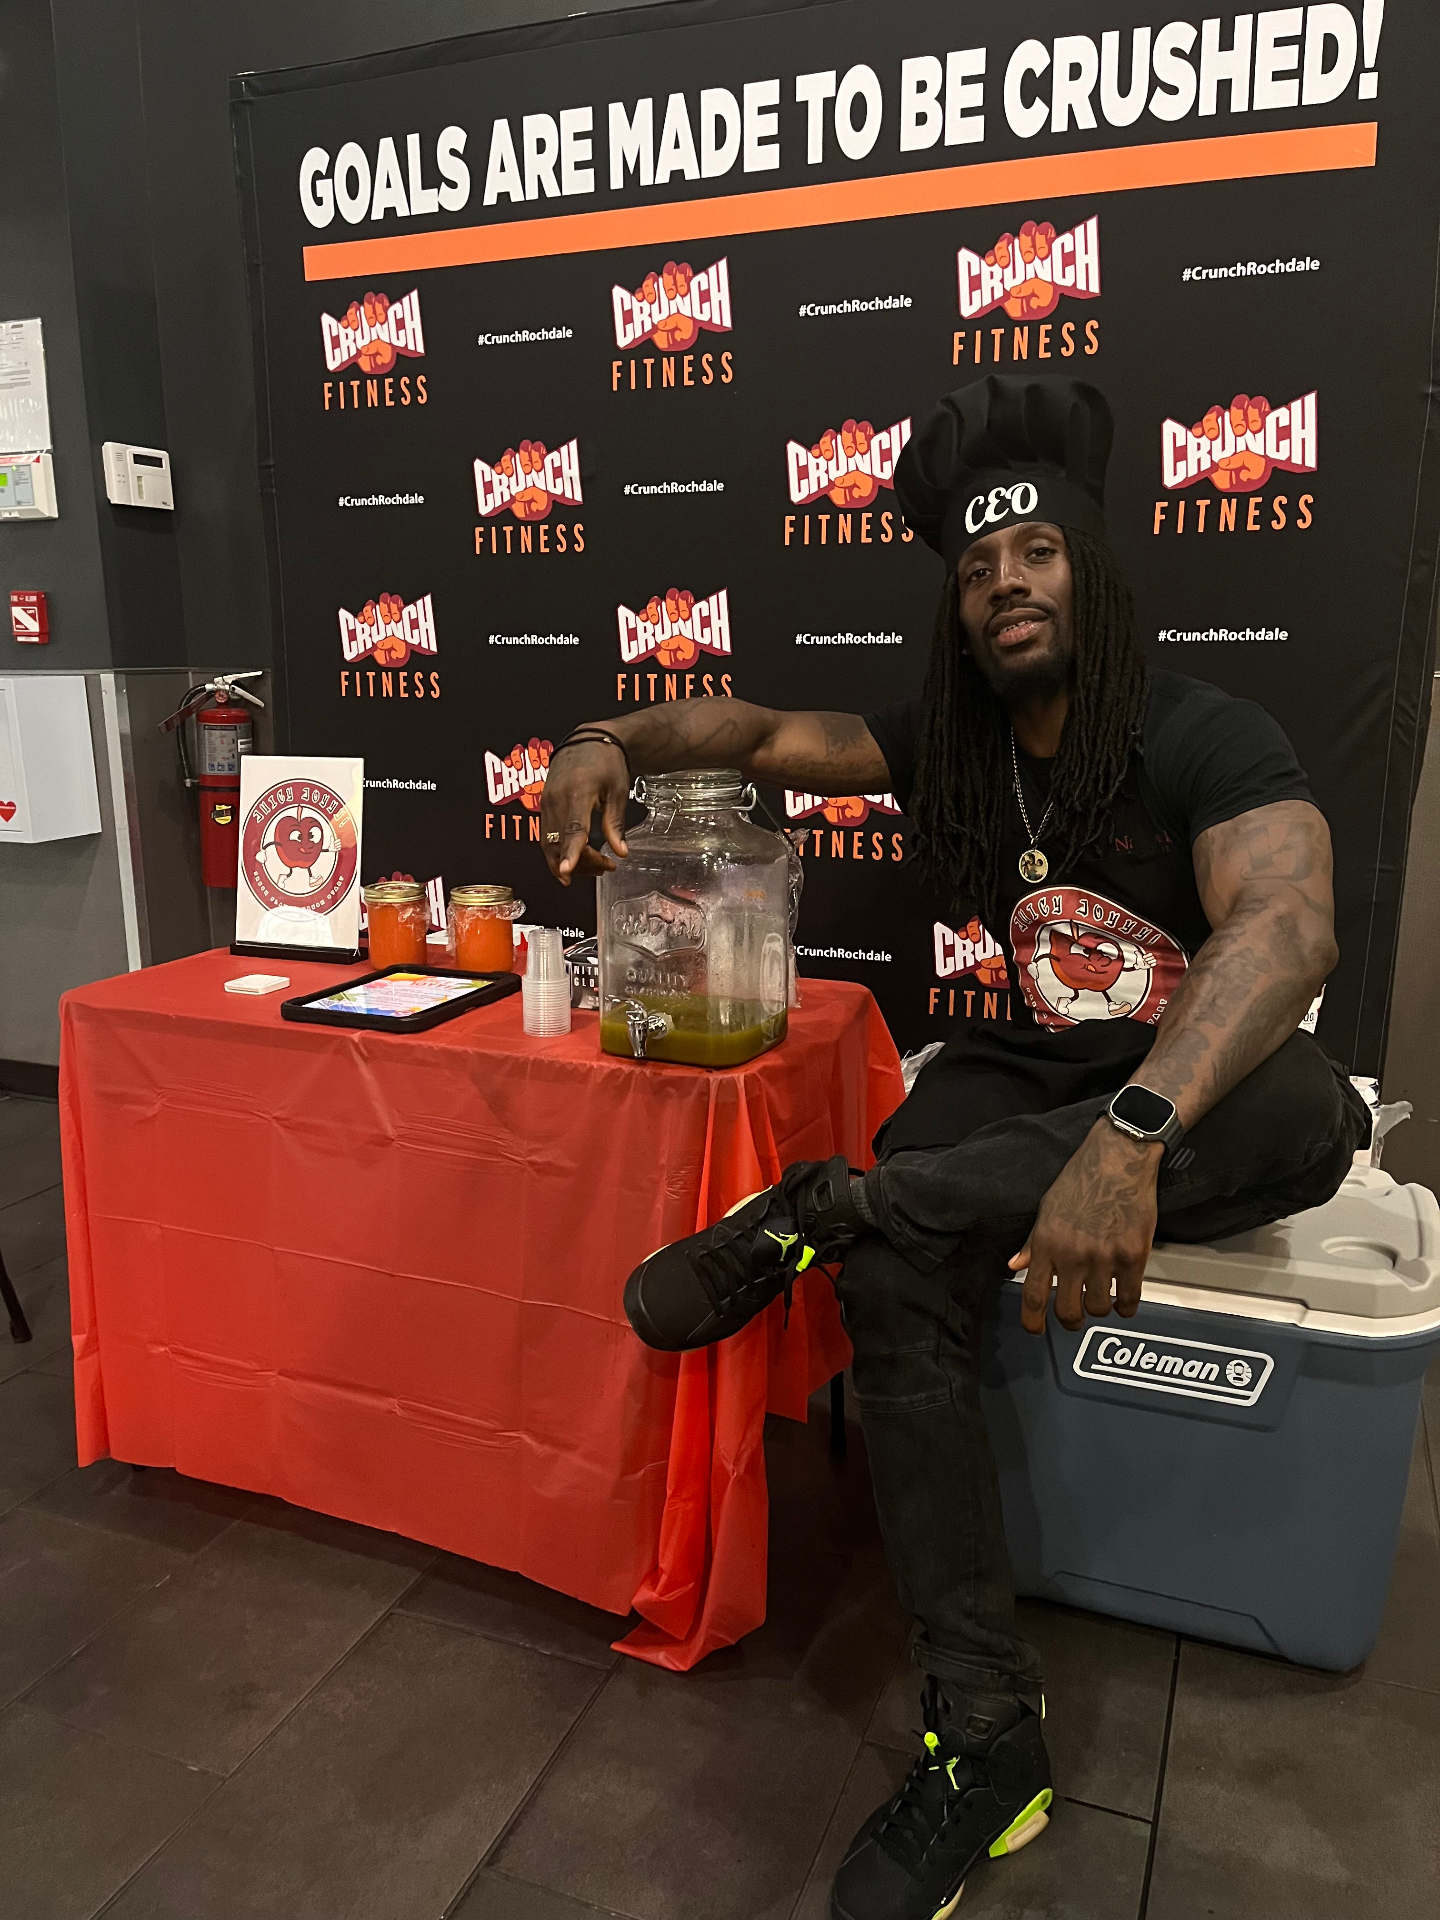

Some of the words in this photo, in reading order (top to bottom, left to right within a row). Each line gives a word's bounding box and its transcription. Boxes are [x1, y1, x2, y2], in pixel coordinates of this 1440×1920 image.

[299, 125, 471, 229] GOALS
[482, 106, 595, 206] ARE
[608, 79, 780, 190] MADE
[795, 64, 883, 165] TO
[900, 47, 987, 153] BE
[1004, 0, 1385, 139] CRUSHED!
[957, 216, 1100, 319] CRUNCH
[1181, 256, 1321, 282] #CrunchRochdale
[611, 258, 733, 350] CRUNCH
[798, 294, 914, 318] #CrunchRochdale
[321, 288, 425, 372] CRUNCH
[477, 326, 573, 346] #CrunchRochdale
[952, 319, 1099, 366] FITNESS
[612, 351, 734, 391] FITNESS
[323, 375, 428, 411] FITNESS
[1162, 392, 1317, 488] CRUNCH
[473, 437, 583, 516] CRUNCH
[623, 479, 725, 496] #CrunchRochdale
[338, 493, 425, 507] #CrunchRochdale
[965, 482, 1040, 534] CEO
[1153, 493, 1314, 535] FITNESS
[474, 523, 585, 555] FITNESS
[338, 592, 438, 663] CRUNCH
[488, 633, 580, 647] #CrunchRochdale
[617, 588, 733, 664] CRUNCH
[795, 632, 903, 646] #CrunchRochdale
[1157, 628, 1289, 643] #CrunchRochdale
[340, 671, 441, 699] FITNESS
[617, 673, 733, 701] FITNESS
[363, 777, 437, 791] runchRochdale
[485, 813, 541, 842] FITN
[784, 828, 903, 861] TNESS
[1013, 895, 1062, 933] JUICY
[793, 945, 892, 962] CrunchRochdale
[933, 921, 1004, 978] CRU
[929, 987, 1012, 1021] FITN
[1097, 1336, 1220, 1383] Coleman
